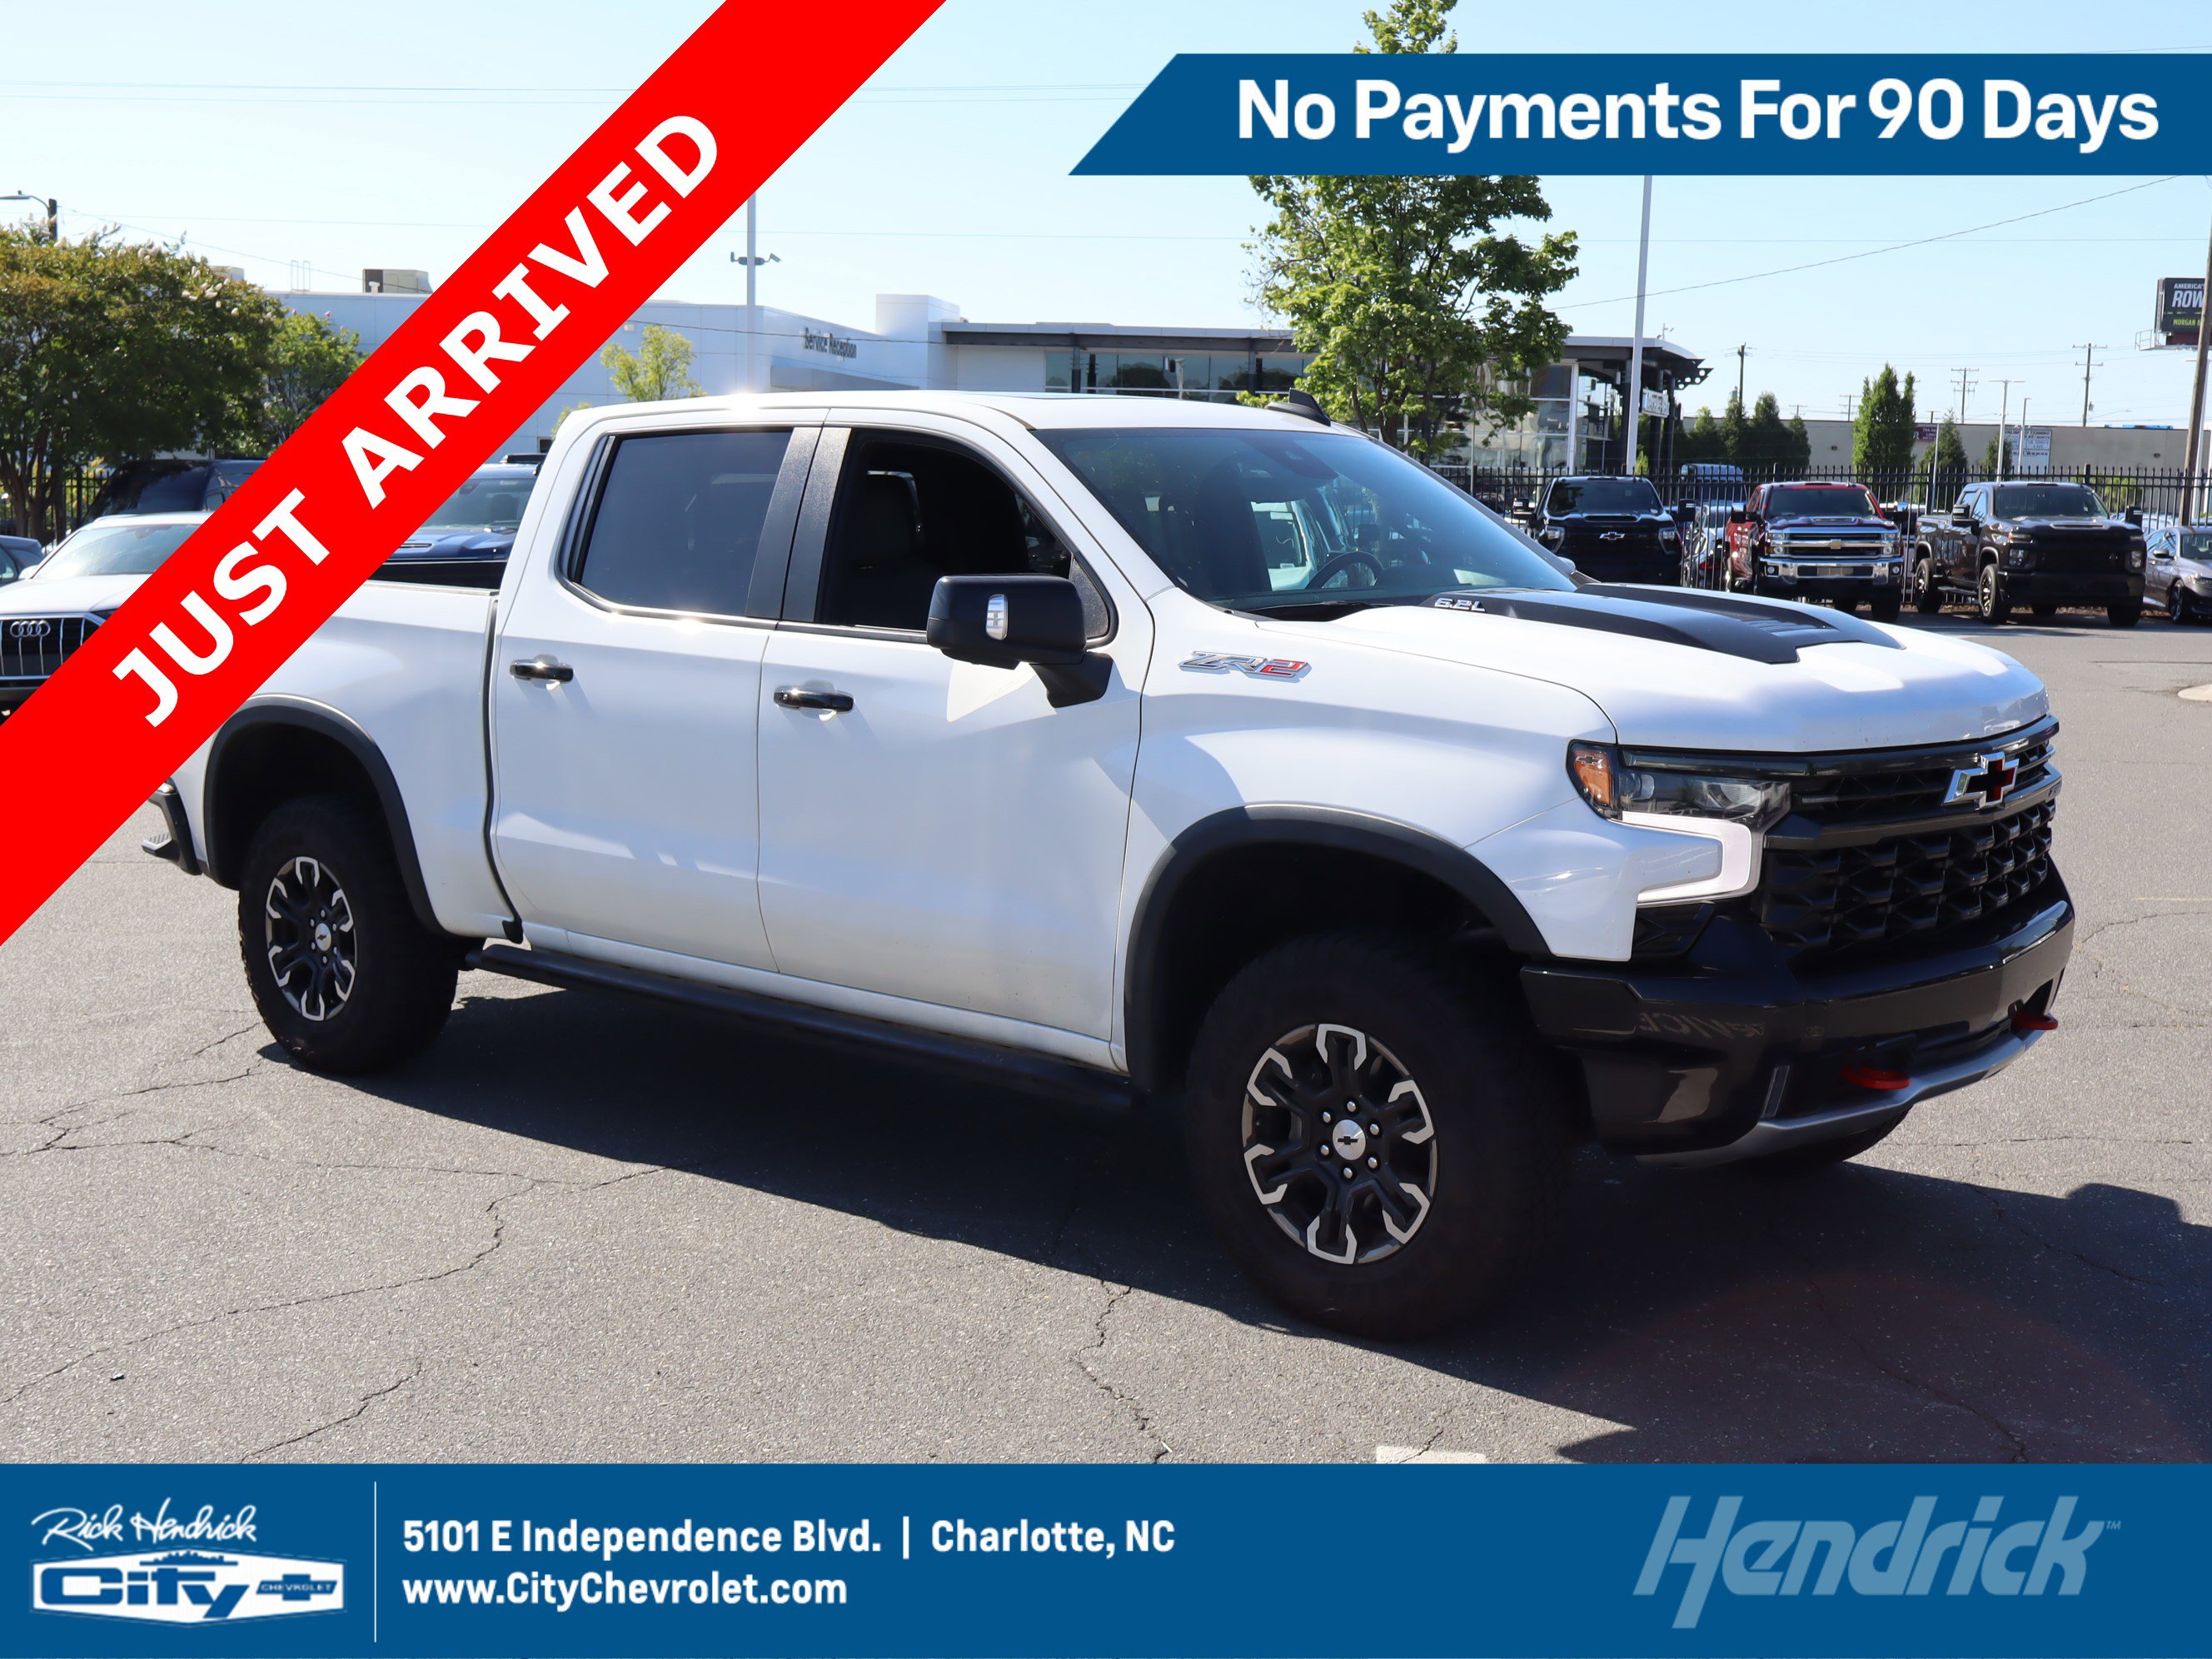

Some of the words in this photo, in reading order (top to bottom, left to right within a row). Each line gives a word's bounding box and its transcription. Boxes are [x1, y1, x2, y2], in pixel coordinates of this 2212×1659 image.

[805, 326, 828, 352] Service
[829, 332, 857, 362] Reception
[1178, 650, 1313, 684] ZR2
